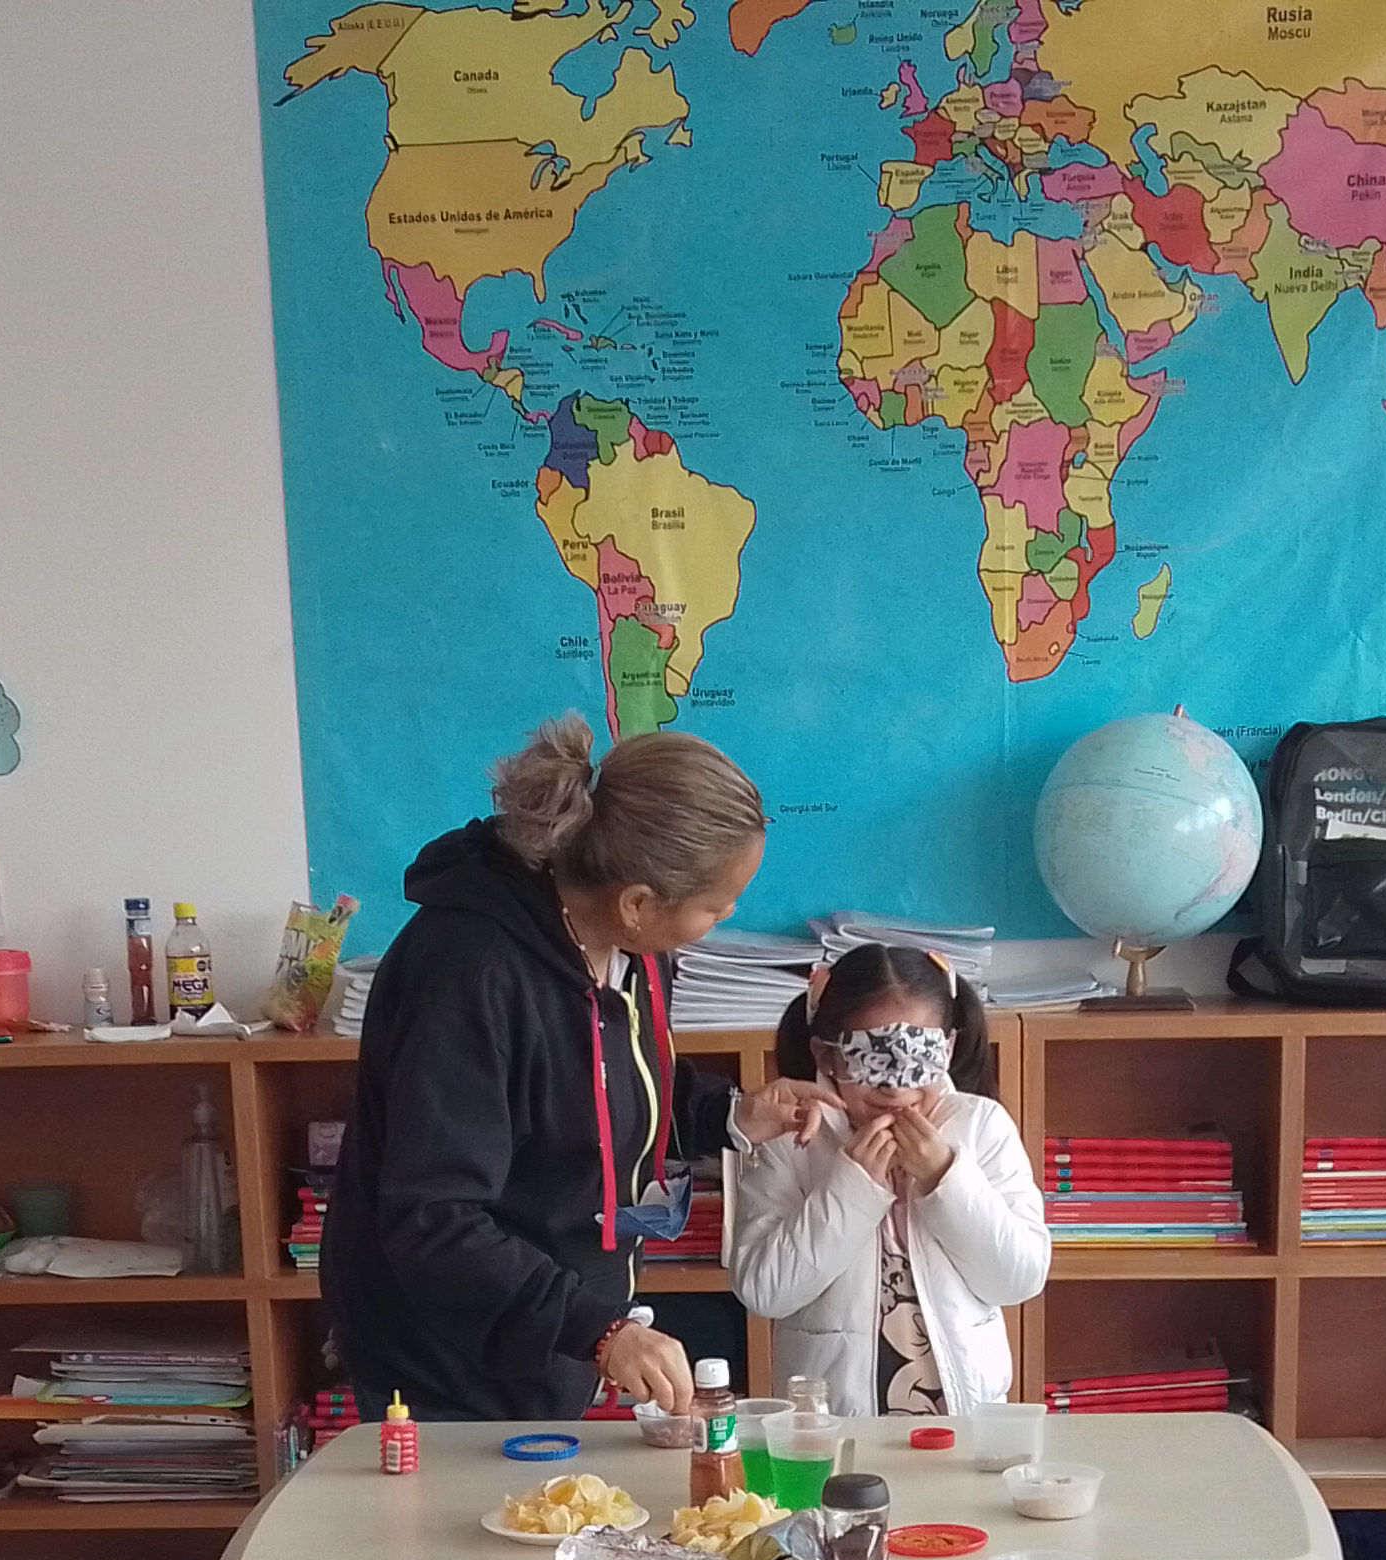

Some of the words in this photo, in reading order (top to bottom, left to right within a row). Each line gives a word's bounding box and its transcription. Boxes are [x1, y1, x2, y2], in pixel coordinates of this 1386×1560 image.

[1266, 6, 1313, 24] Rusia
[453, 68, 500, 83] Canada
[820, 152, 859, 164] Portugal
[1346, 173, 1386, 188] China
[388, 211, 437, 225] Estados
[439, 210, 483, 223] Unidos
[485, 208, 501, 221] de
[503, 206, 554, 221] América
[1288, 265, 1324, 279] India
[1274, 281, 1309, 294] Nueva
[1310, 279, 1339, 293] Delhi
[491, 478, 530, 490] Ecuador
[651, 507, 685, 520] Brasil
[565, 551, 587, 562] Lima
[602, 572, 642, 585] Bolivia
[634, 601, 687, 616] Paraguay
[560, 636, 589, 649] Chile
[555, 647, 595, 660] Santiago
[691, 687, 735, 701] Uruguay
[1235, 725, 1283, 738] (Francia)
